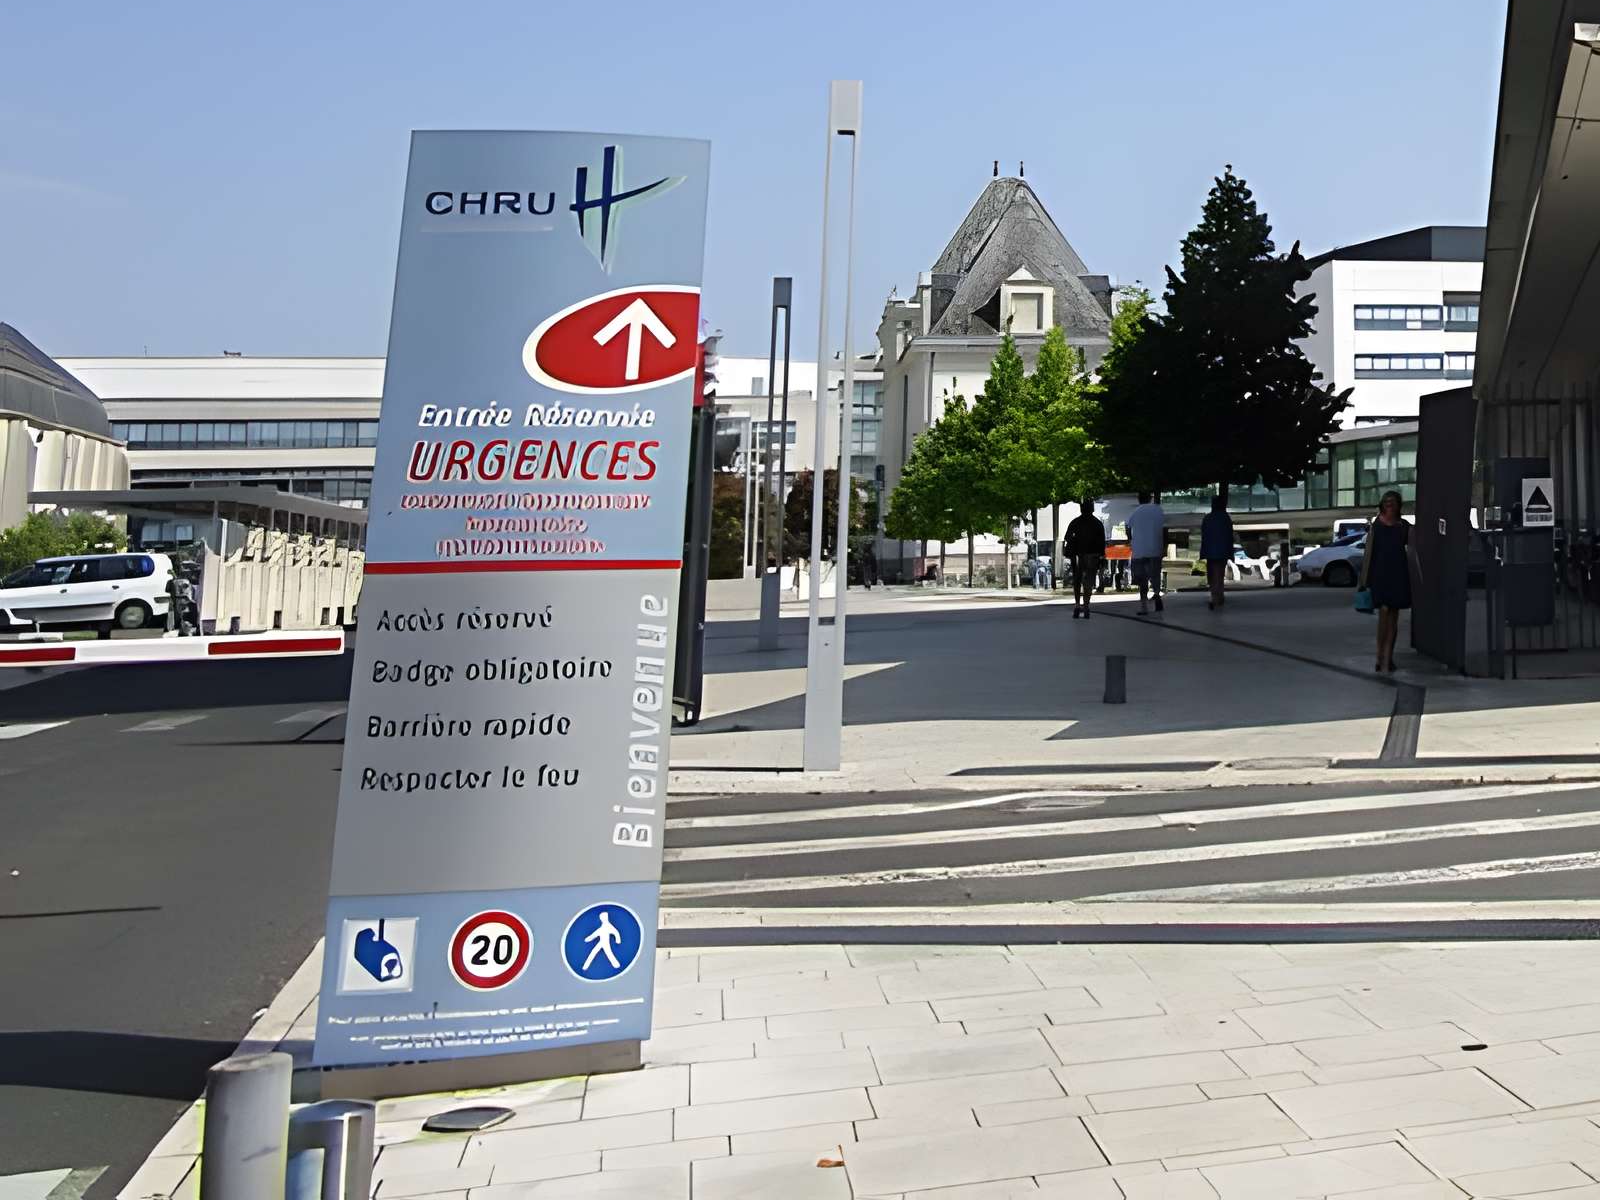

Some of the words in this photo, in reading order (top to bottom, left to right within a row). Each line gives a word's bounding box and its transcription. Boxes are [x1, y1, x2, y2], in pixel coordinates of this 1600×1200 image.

[425, 190, 556, 216] CHRU
[407, 439, 660, 482] URGENCES
[465, 656, 613, 685] obligatoire
[483, 713, 571, 739] rapide
[612, 593, 669, 848] Bienvenue
[502, 765, 525, 789] le
[537, 763, 580, 788] feu
[470, 933, 514, 966] 20
